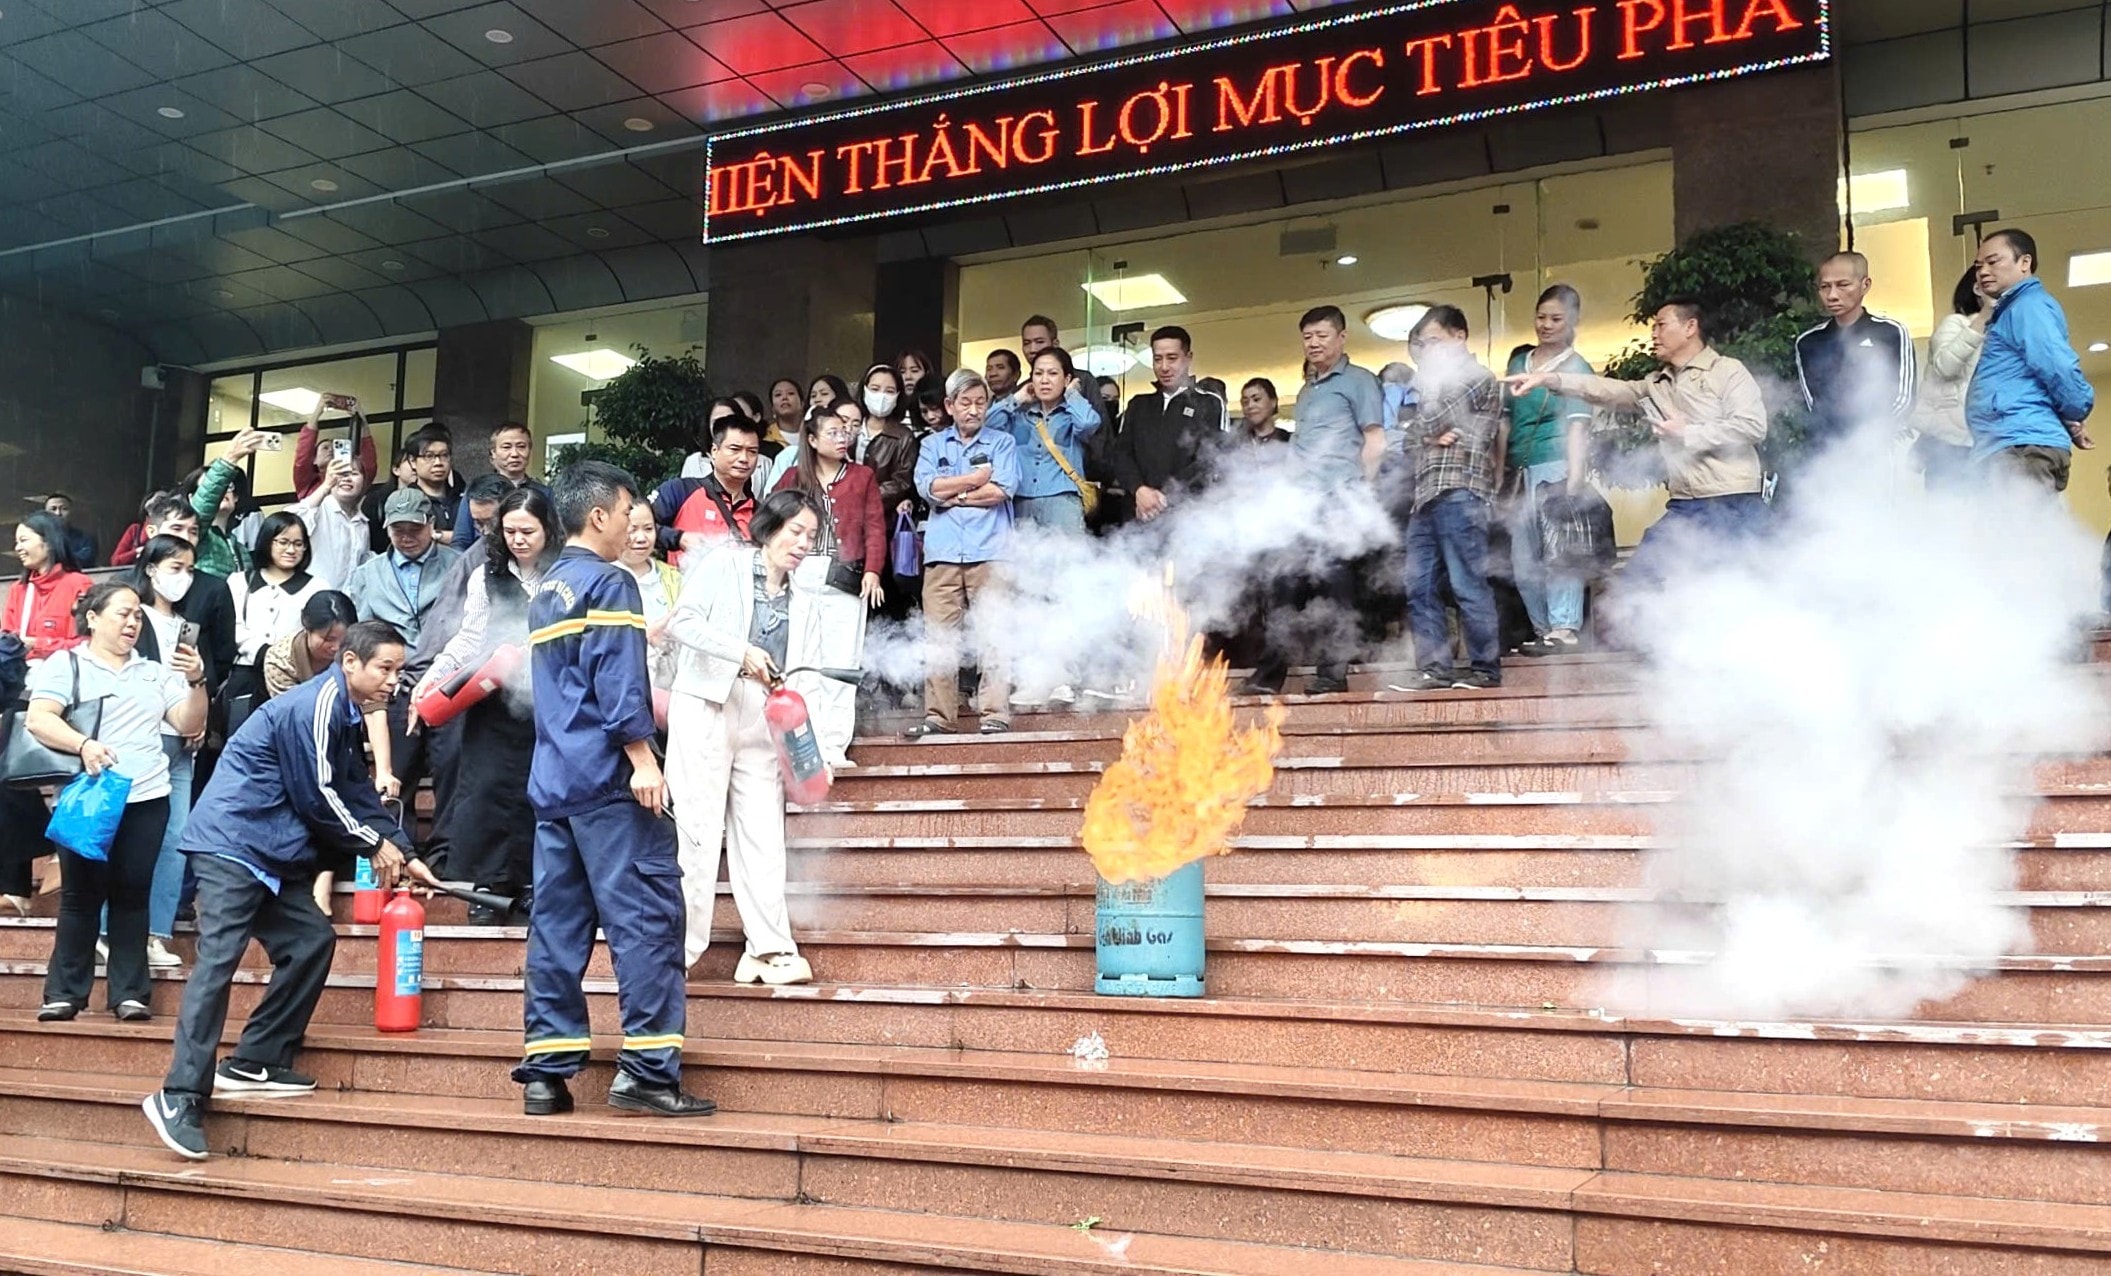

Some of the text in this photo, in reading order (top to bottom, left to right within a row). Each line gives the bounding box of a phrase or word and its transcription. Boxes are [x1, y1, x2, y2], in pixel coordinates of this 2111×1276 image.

[838, 112, 1061, 194] THẮNG
[1076, 80, 1195, 155] LỢI
[1212, 48, 1386, 128] MỤC
[1406, 5, 1595, 96] TIÊU
